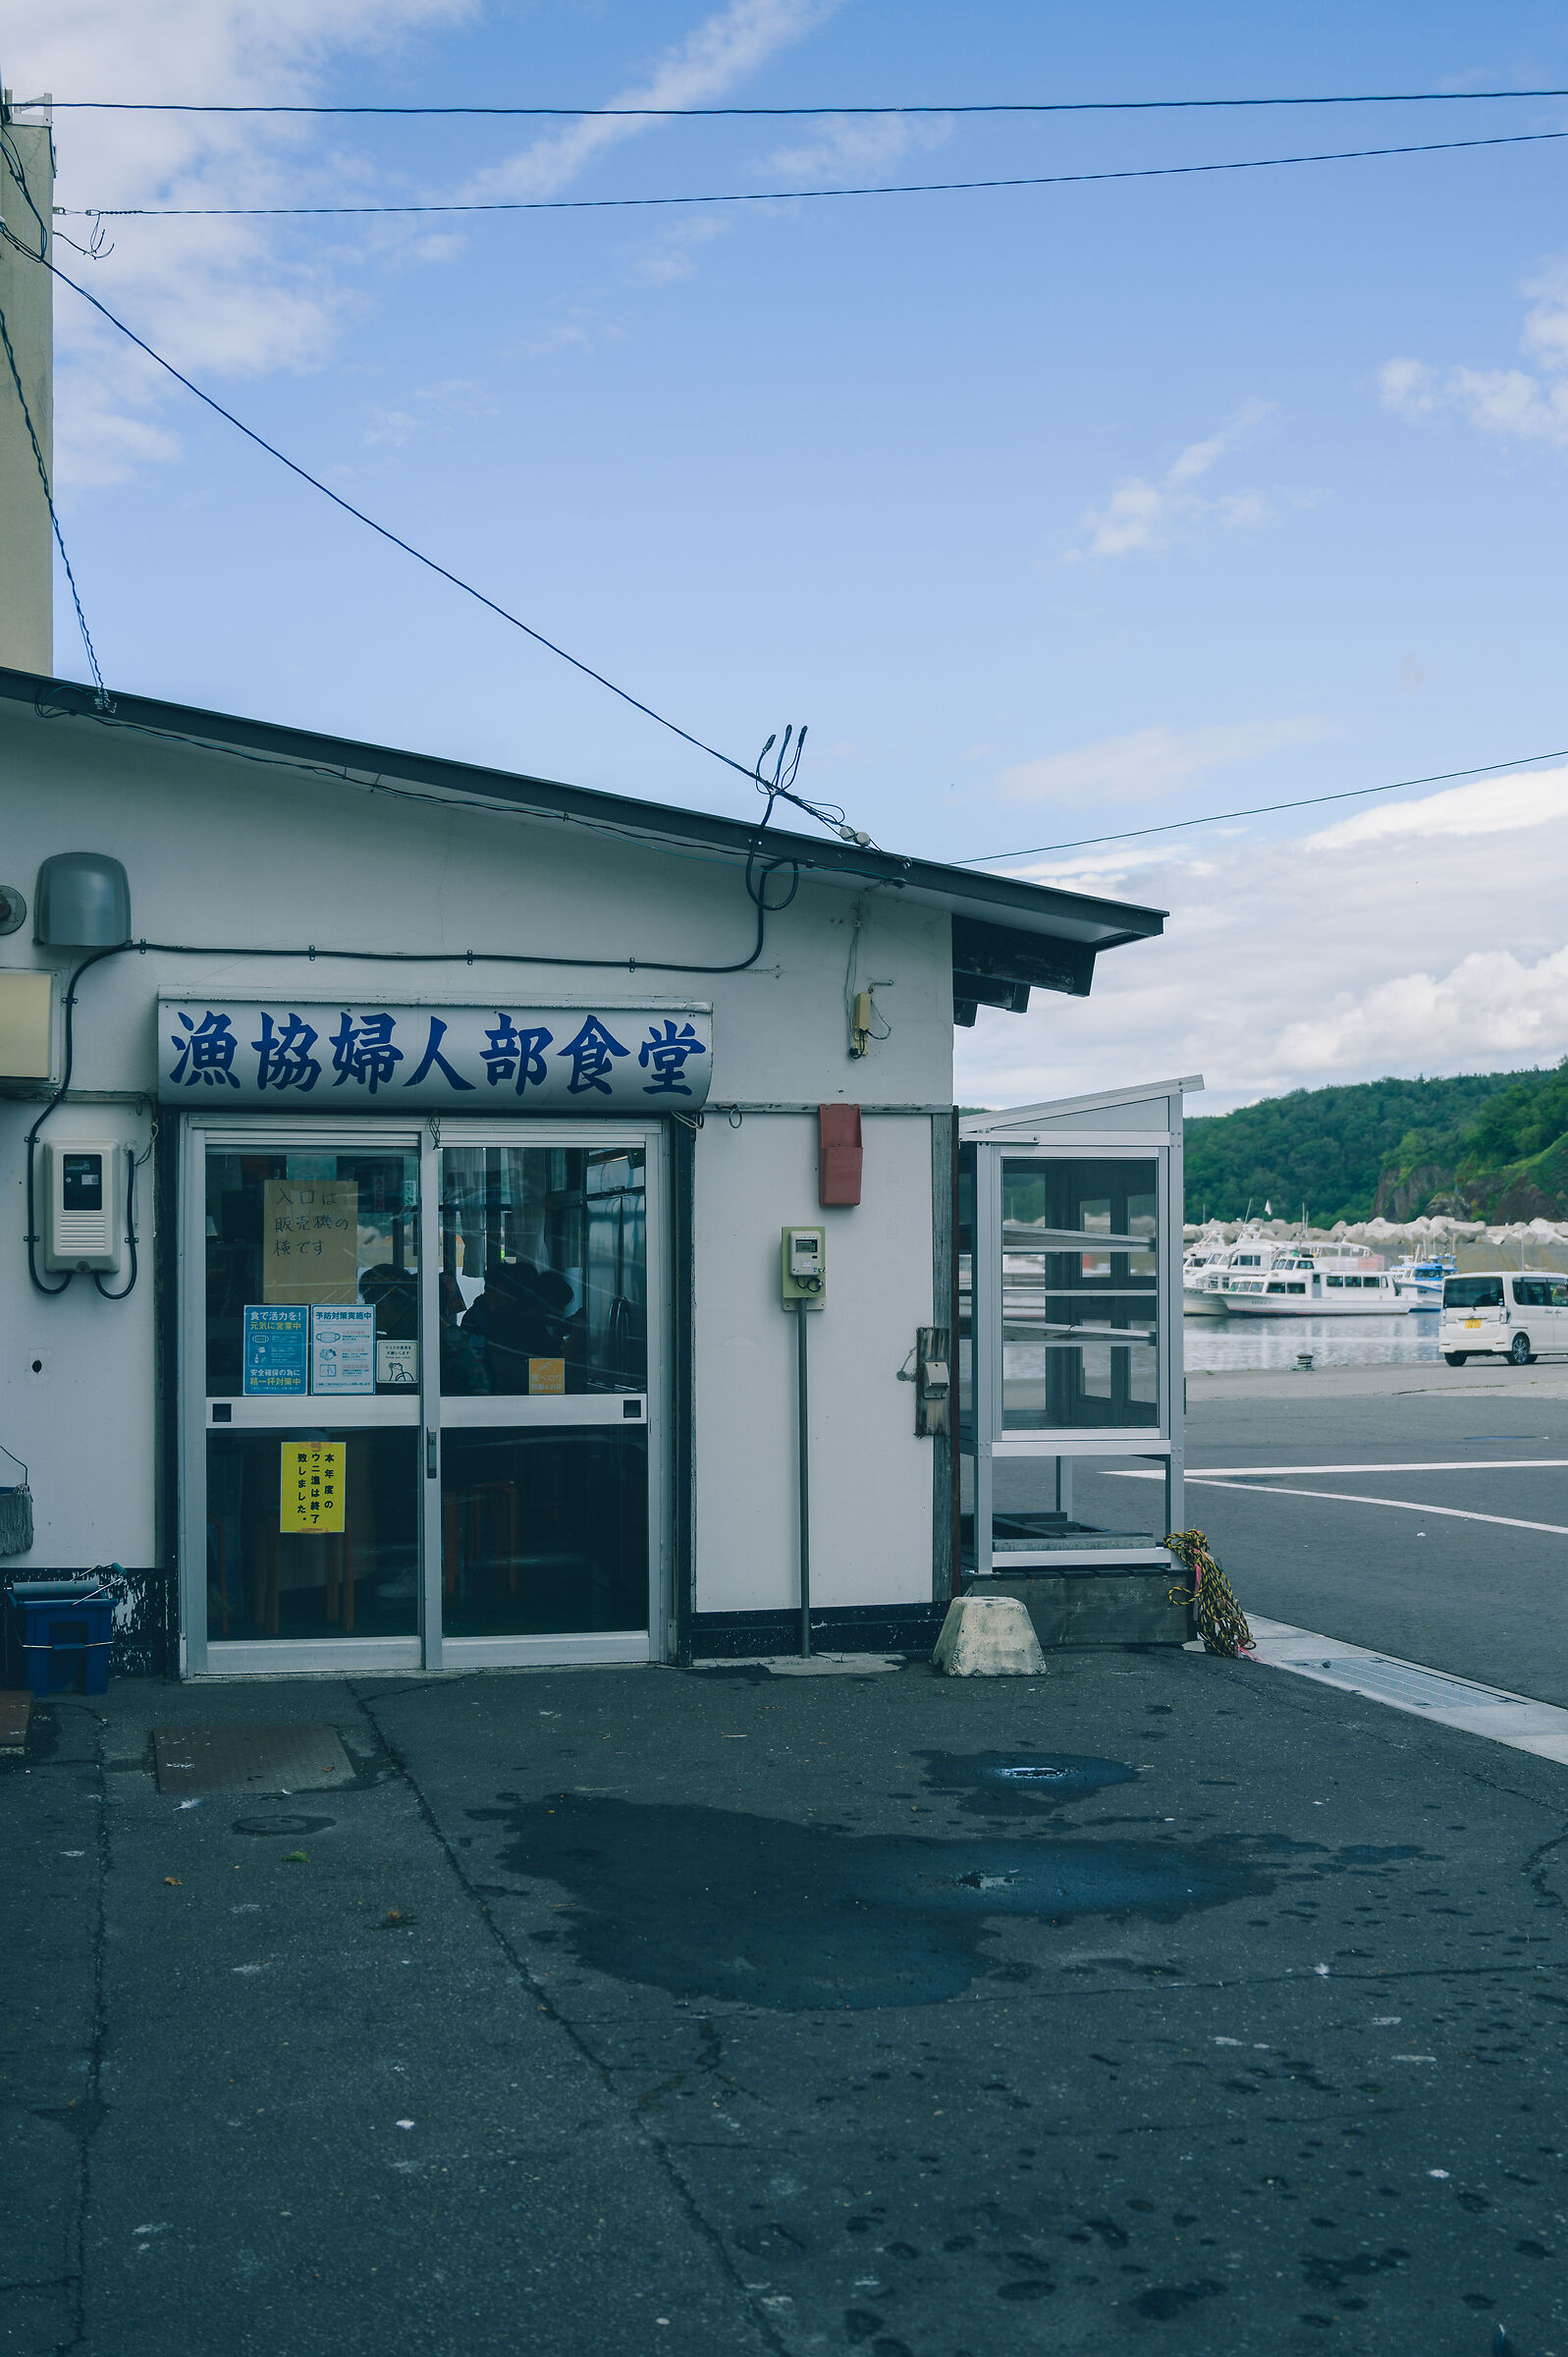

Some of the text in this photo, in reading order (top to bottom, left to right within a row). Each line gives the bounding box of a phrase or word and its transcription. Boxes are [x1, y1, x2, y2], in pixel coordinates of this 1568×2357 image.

[170, 1010, 707, 1096] 漁協婦人部食堂
[276, 1187, 338, 1206] 入口は
[275, 1214, 349, 1233] 販売機の
[273, 1240, 324, 1257] 横です
[315, 1311, 372, 1321] 予防対策実施中
[297, 1453, 307, 1521] 致しました。
[310, 1453, 321, 1524] ウニ漁は終了
[324, 1453, 335, 1509] 本年度の
